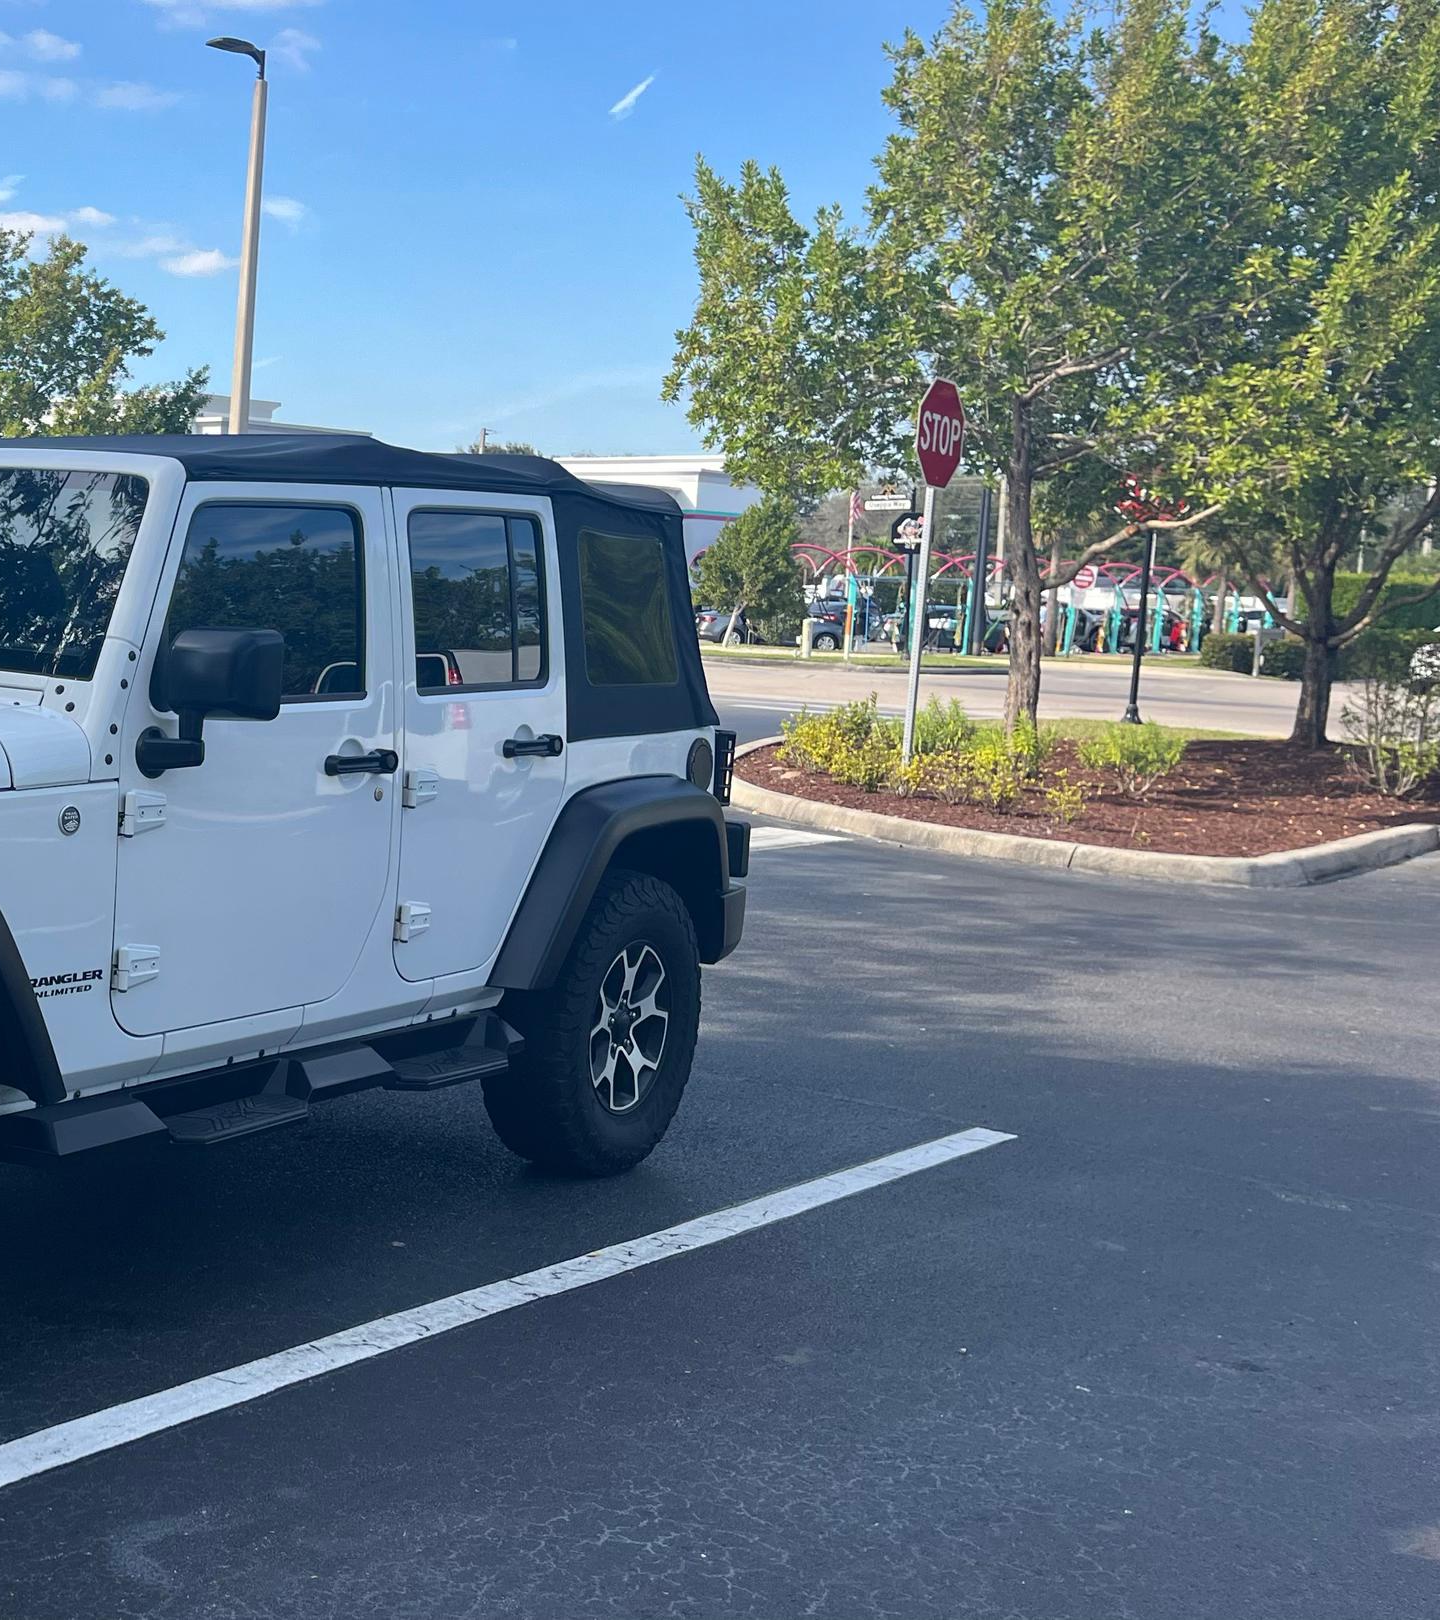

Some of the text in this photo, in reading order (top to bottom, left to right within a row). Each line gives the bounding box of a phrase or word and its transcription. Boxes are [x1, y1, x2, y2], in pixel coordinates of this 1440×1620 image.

[921, 410, 961, 457] STOP
[30, 969, 103, 988] RANGLER
[35, 984, 92, 998] NLIMITED
